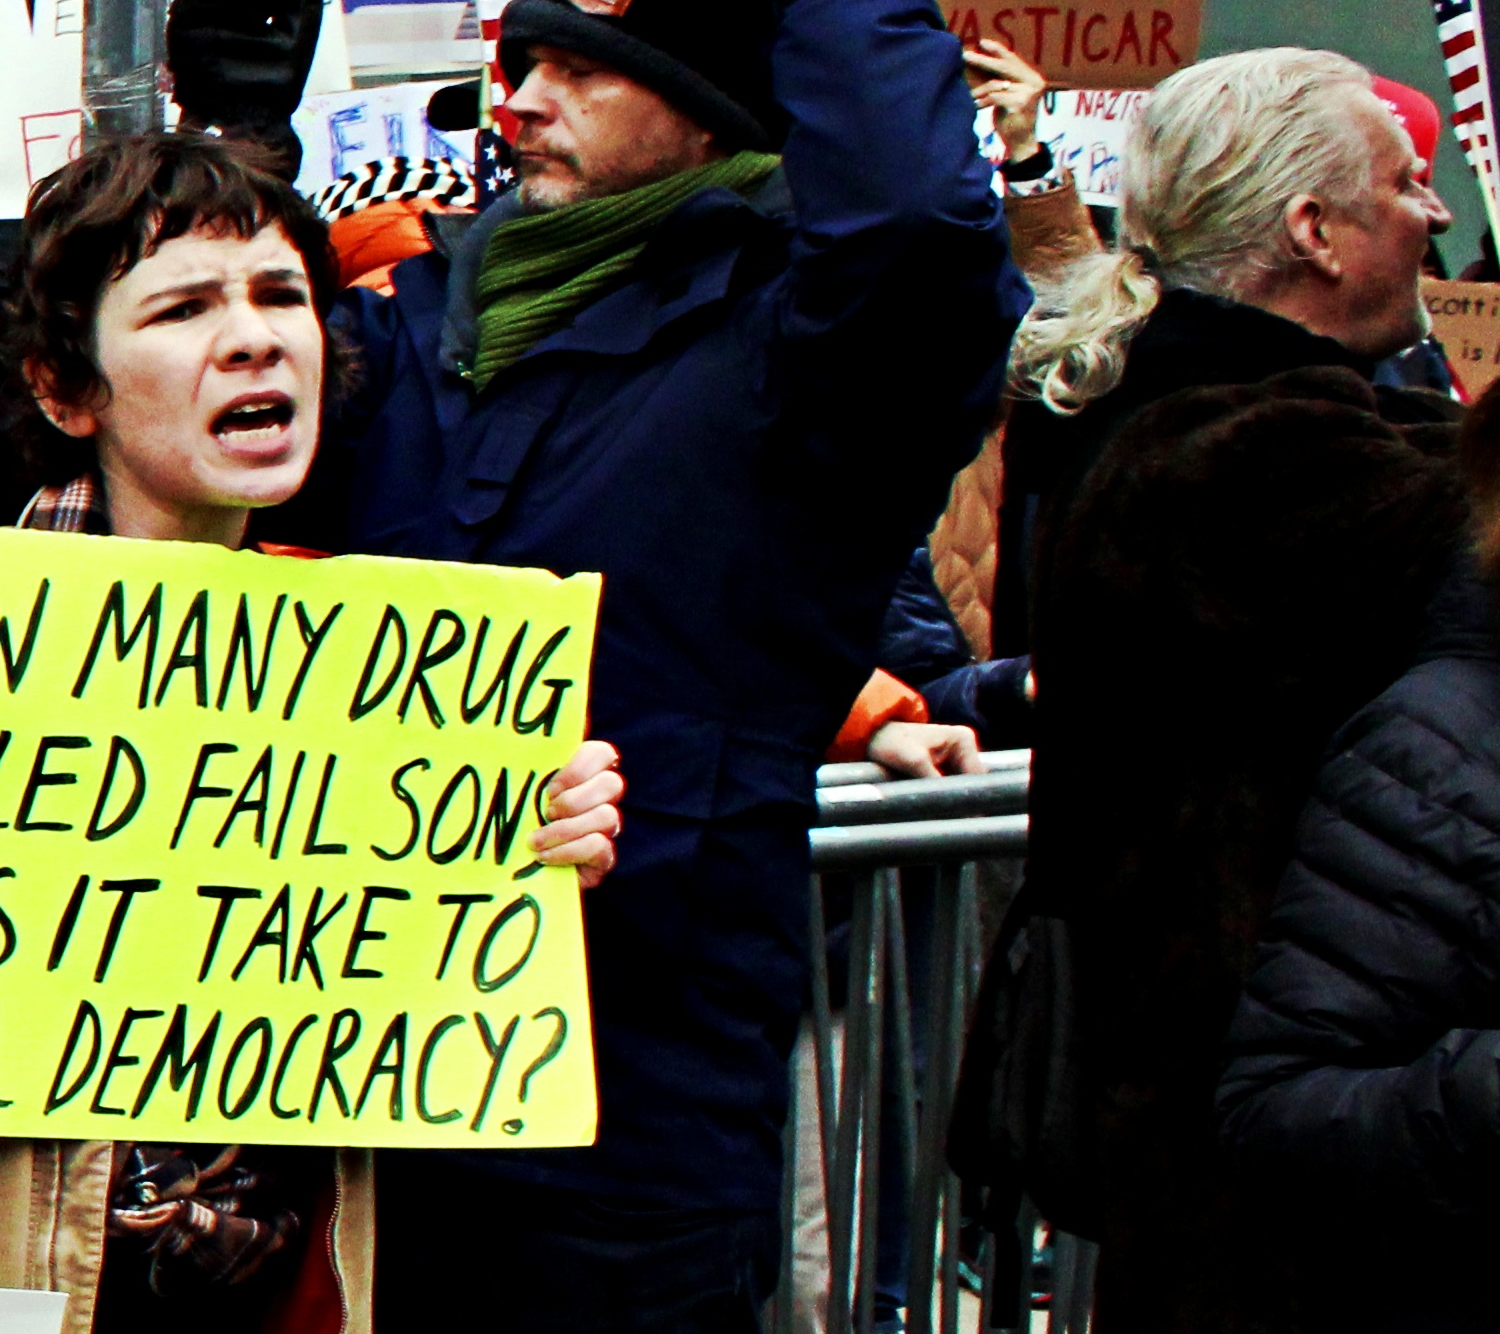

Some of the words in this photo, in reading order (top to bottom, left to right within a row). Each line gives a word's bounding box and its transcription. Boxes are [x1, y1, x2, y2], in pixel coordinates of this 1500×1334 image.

[71, 579, 344, 721] MANY
[349, 604, 574, 737] DRUG
[169, 742, 348, 860] FAIL
[47, 873, 161, 983] IT
[197, 883, 412, 991] TAKE
[436, 890, 542, 994] TO
[44, 999, 569, 1135] DEMOCRACY?
